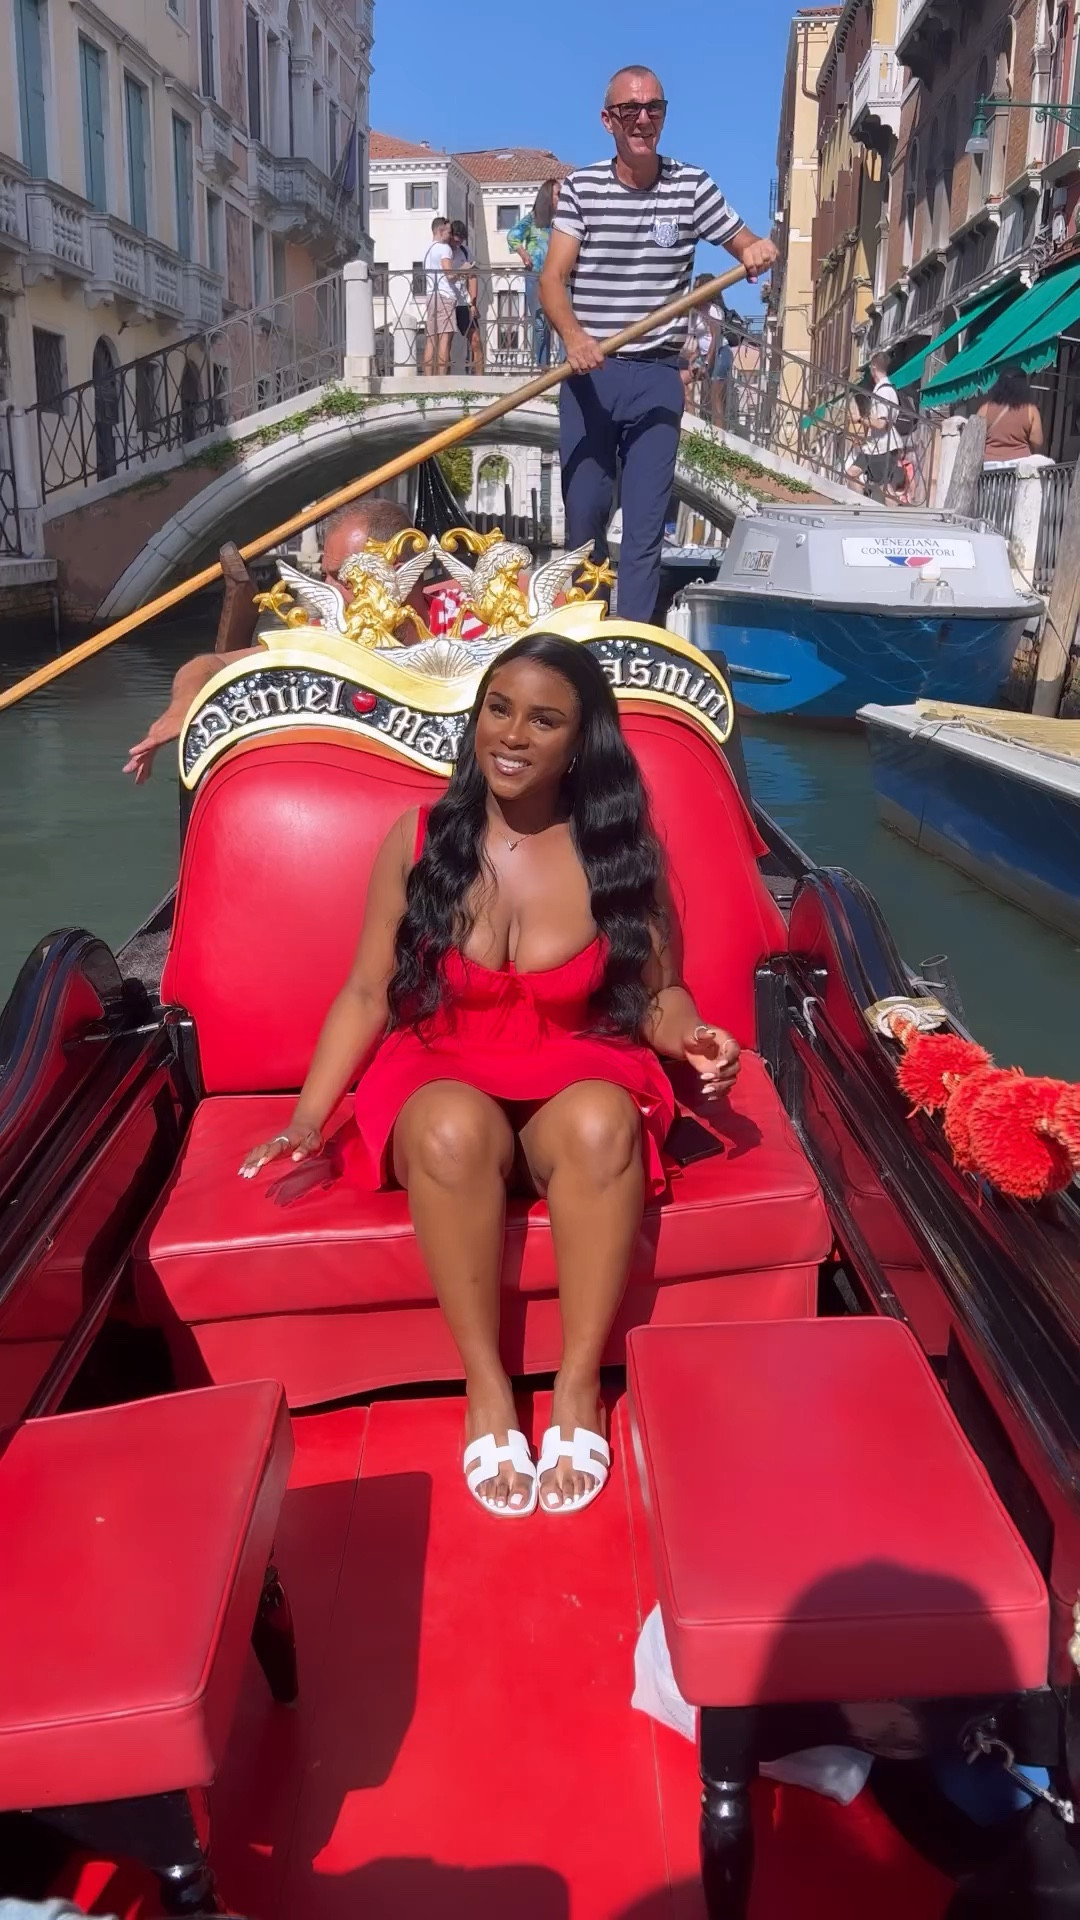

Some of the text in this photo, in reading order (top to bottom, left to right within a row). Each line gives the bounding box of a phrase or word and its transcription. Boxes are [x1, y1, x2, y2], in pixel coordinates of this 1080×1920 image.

[874, 538, 940, 548] VENEZIANA
[861, 547, 955, 557] CONDIZIONATORI
[191, 677, 344, 746] Daniel
[599, 657, 726, 719] asmin
